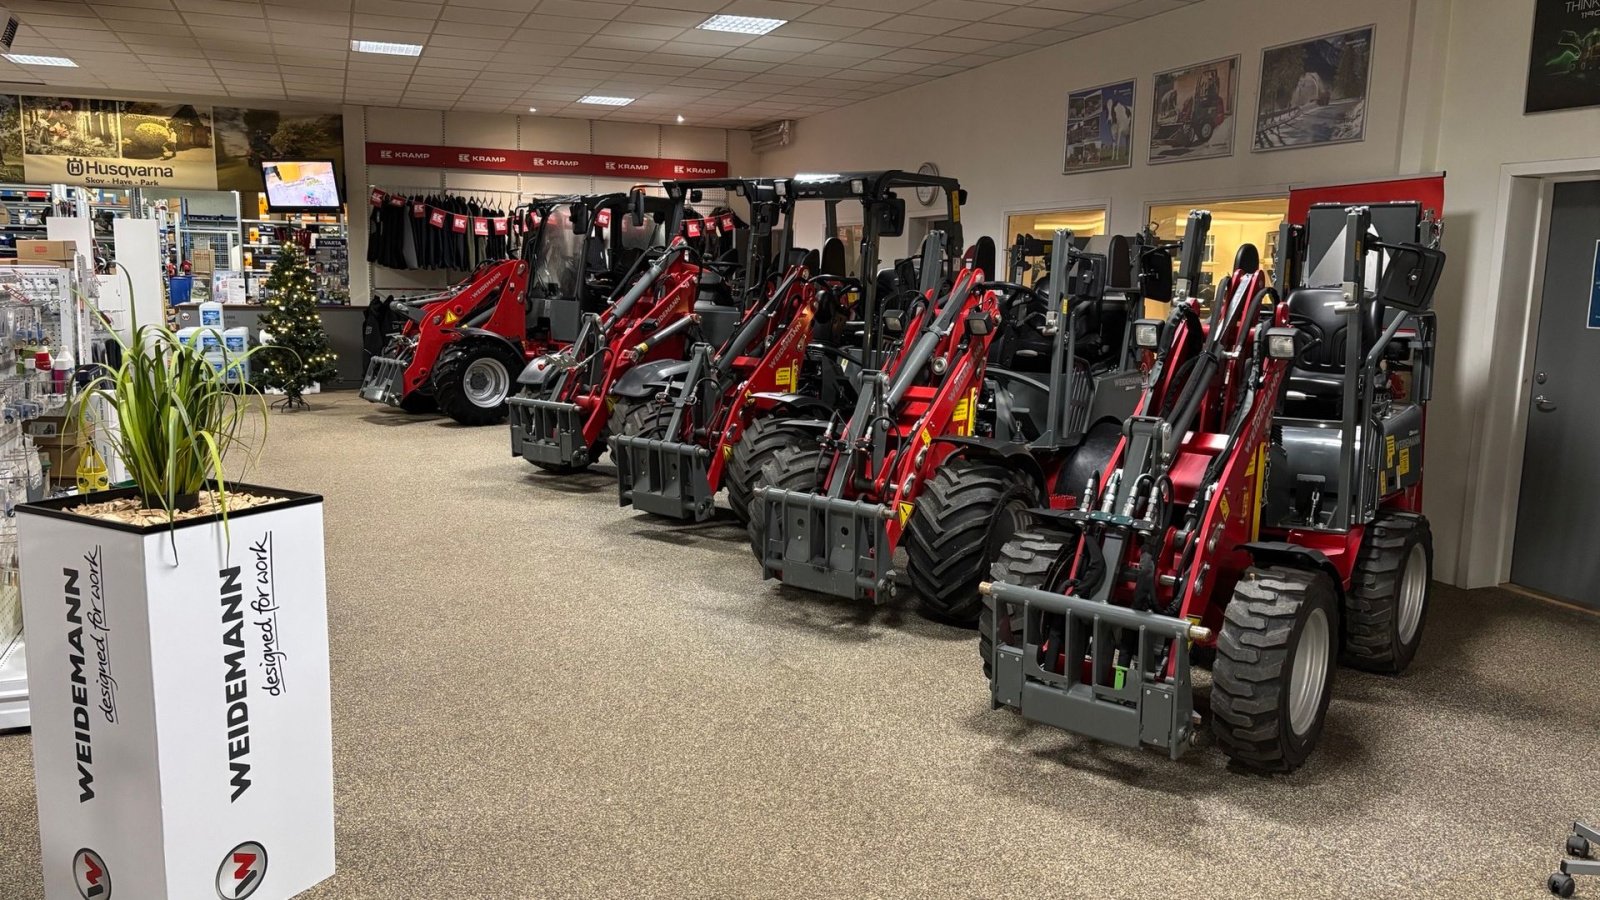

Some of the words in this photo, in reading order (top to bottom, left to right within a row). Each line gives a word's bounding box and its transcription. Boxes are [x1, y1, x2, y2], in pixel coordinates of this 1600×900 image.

[86, 161, 174, 178] Husqvarna
[394, 151, 431, 161] KRAMP
[472, 155, 507, 164] KRAMP
[546, 159, 580, 168] KRAMP
[617, 162, 650, 171] KRAMP
[685, 166, 717, 175] KRAMP
[472, 272, 502, 298] WEIDEMANN
[768, 322, 803, 369] WEIDEMANN
[83, 545, 98, 597] work
[249, 530, 269, 582] work
[251, 582, 279, 613] for
[88, 597, 111, 632] for
[254, 618, 287, 697] designed
[63, 567, 95, 804] WEIDEMANN
[90, 633, 119, 723] designed
[219, 565, 252, 804] WEIDEMANN
